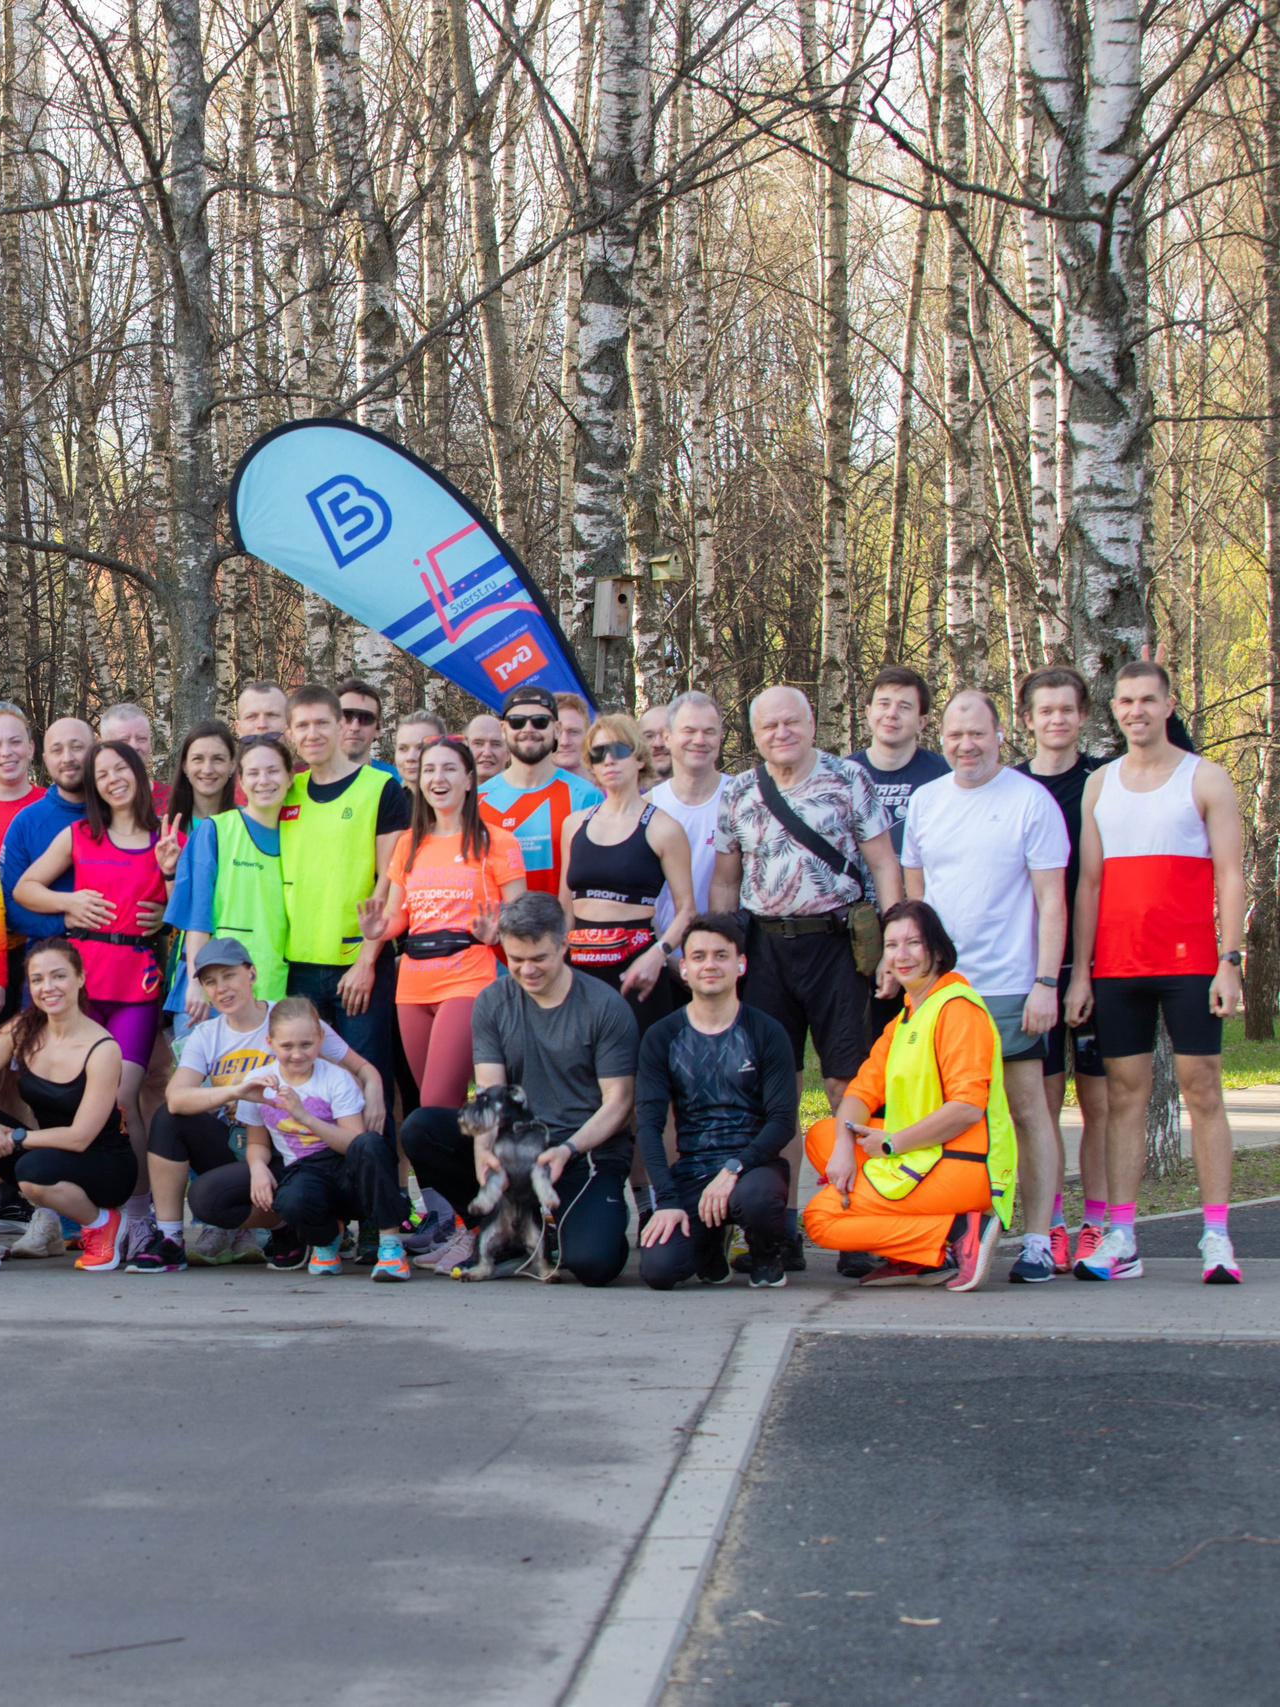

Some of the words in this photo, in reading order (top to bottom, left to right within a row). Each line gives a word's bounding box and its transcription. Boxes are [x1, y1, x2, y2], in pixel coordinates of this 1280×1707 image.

[449, 581, 498, 615] 5verst.ru
[874, 784, 912, 796] APS
[586, 889, 629, 902] PROFIT
